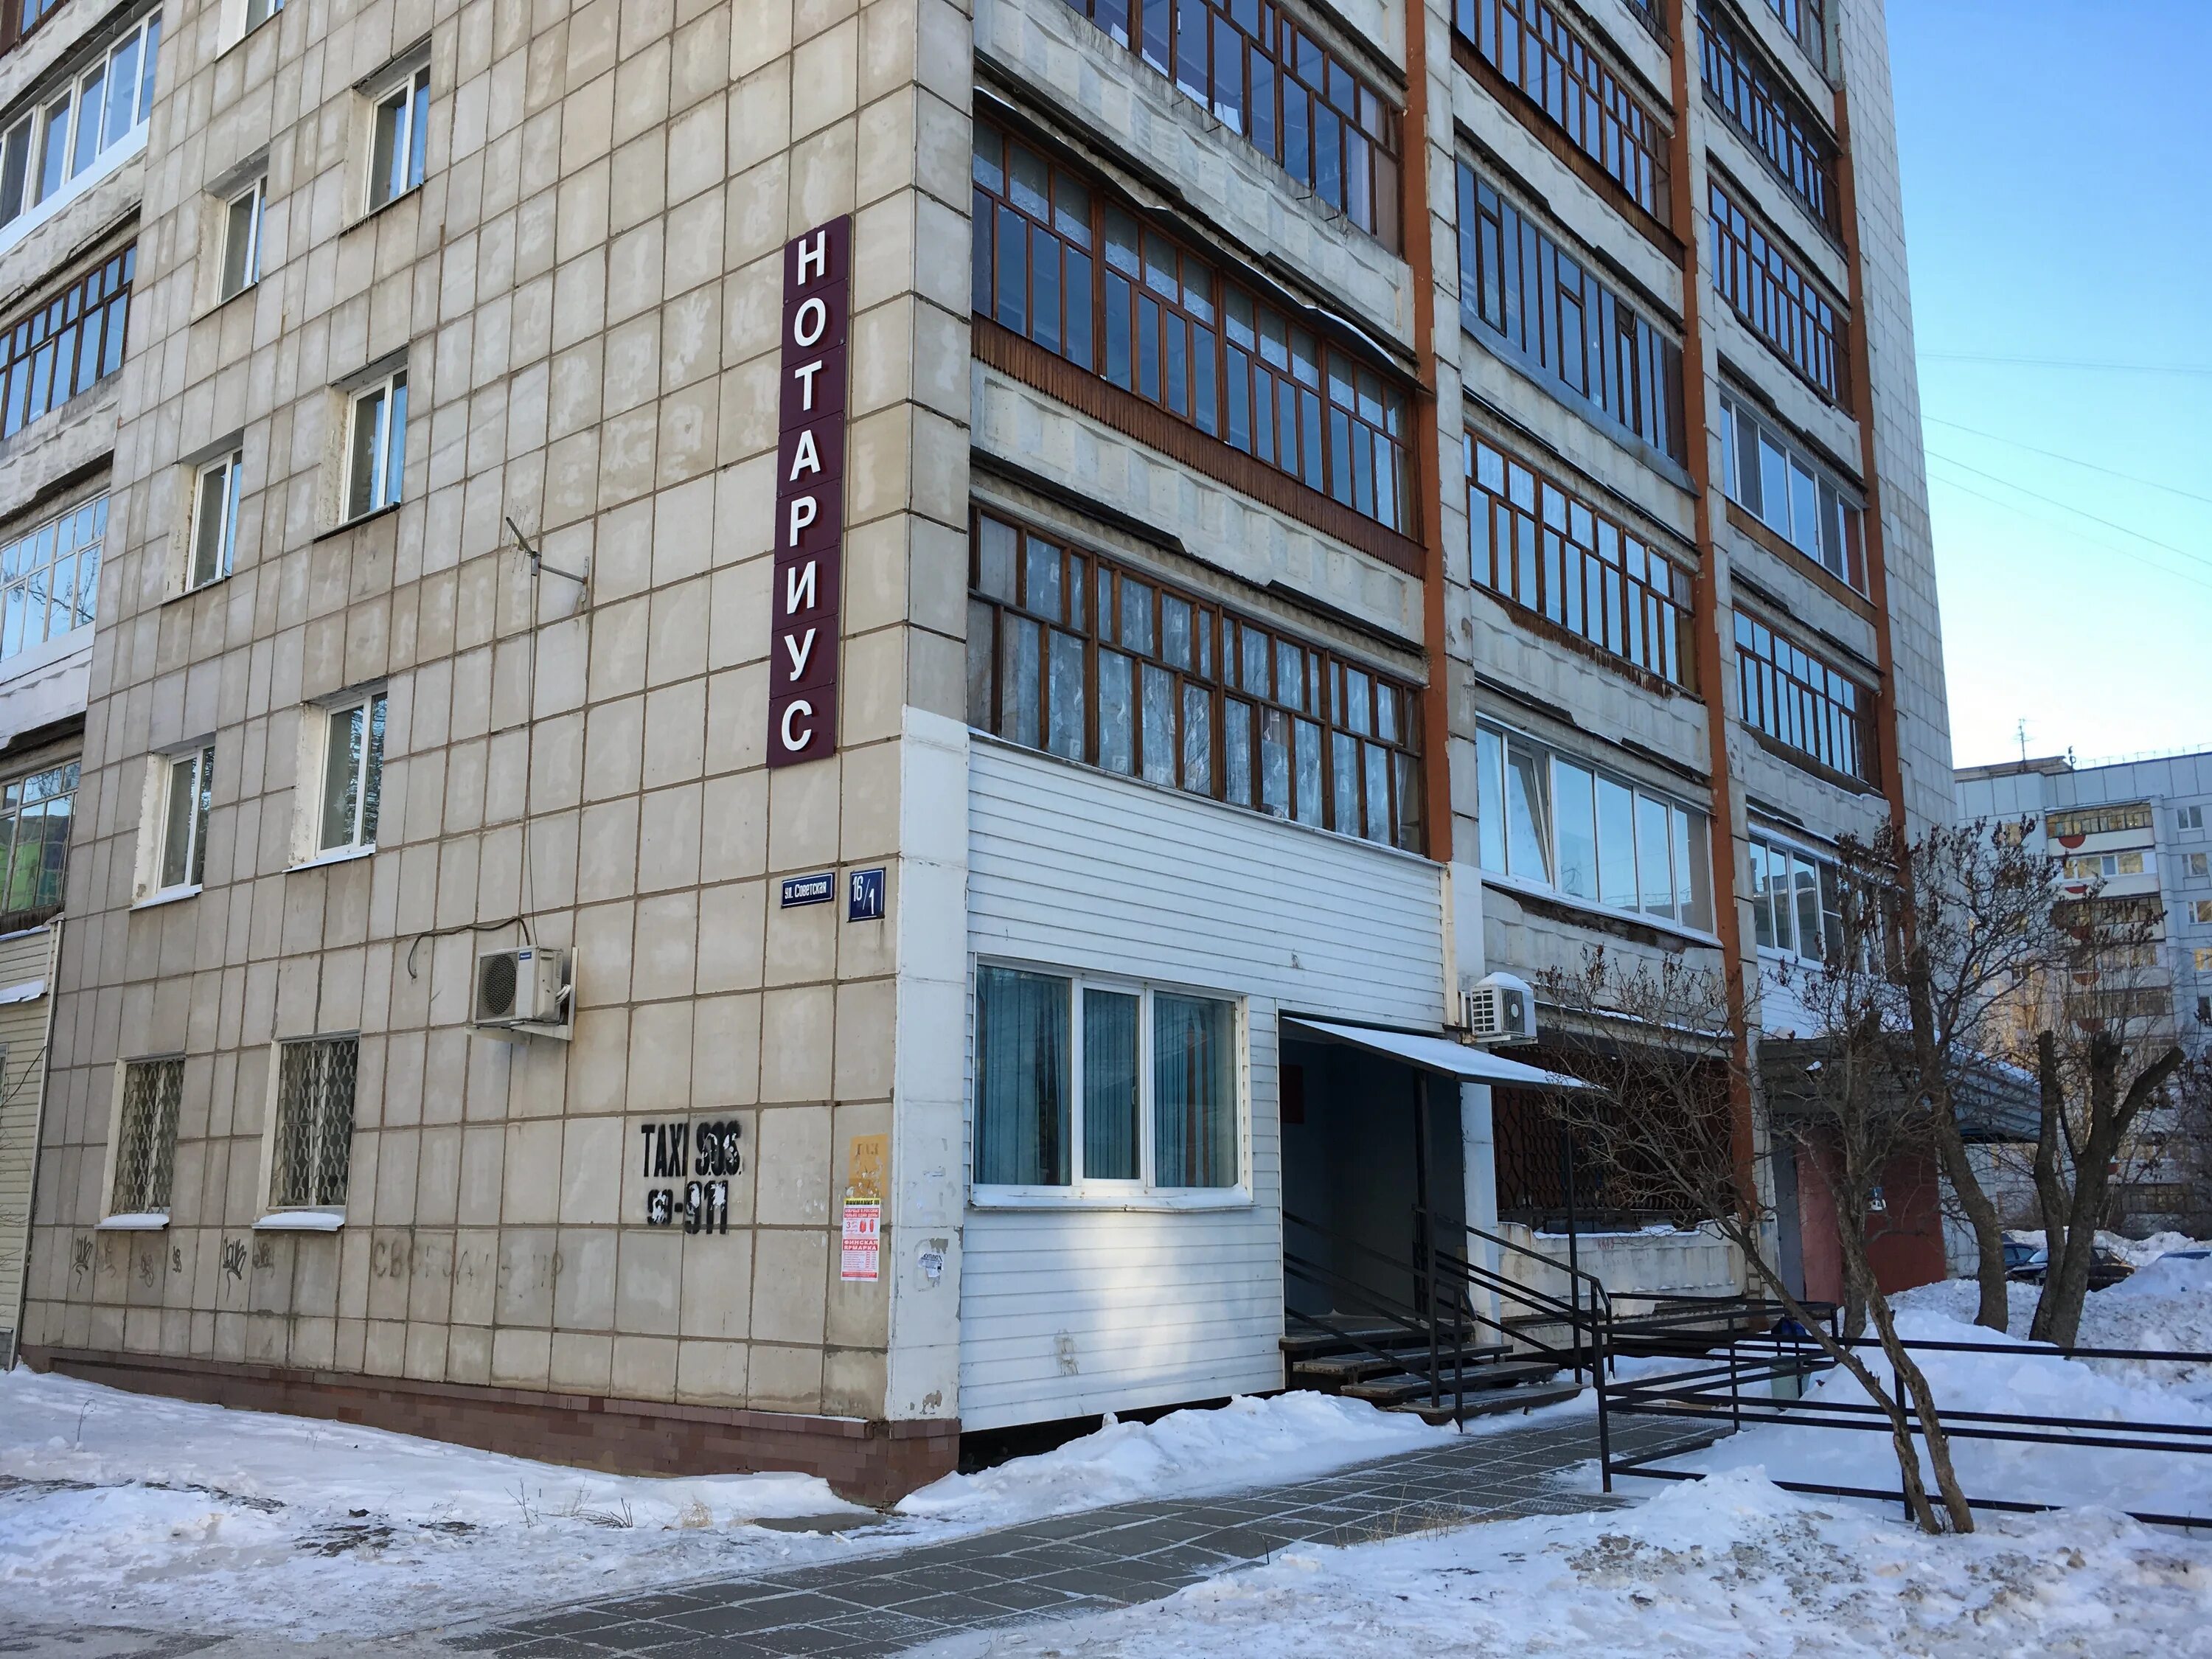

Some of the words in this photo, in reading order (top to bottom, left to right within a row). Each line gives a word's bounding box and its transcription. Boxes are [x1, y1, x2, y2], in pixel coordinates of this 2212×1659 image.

[781, 229, 827, 751] НОТАРИУС
[785, 886, 793, 899] ул.
[795, 881, 827, 897] Советская
[852, 875, 874, 914] 16/1
[641, 1122, 689, 1177] TAXI
